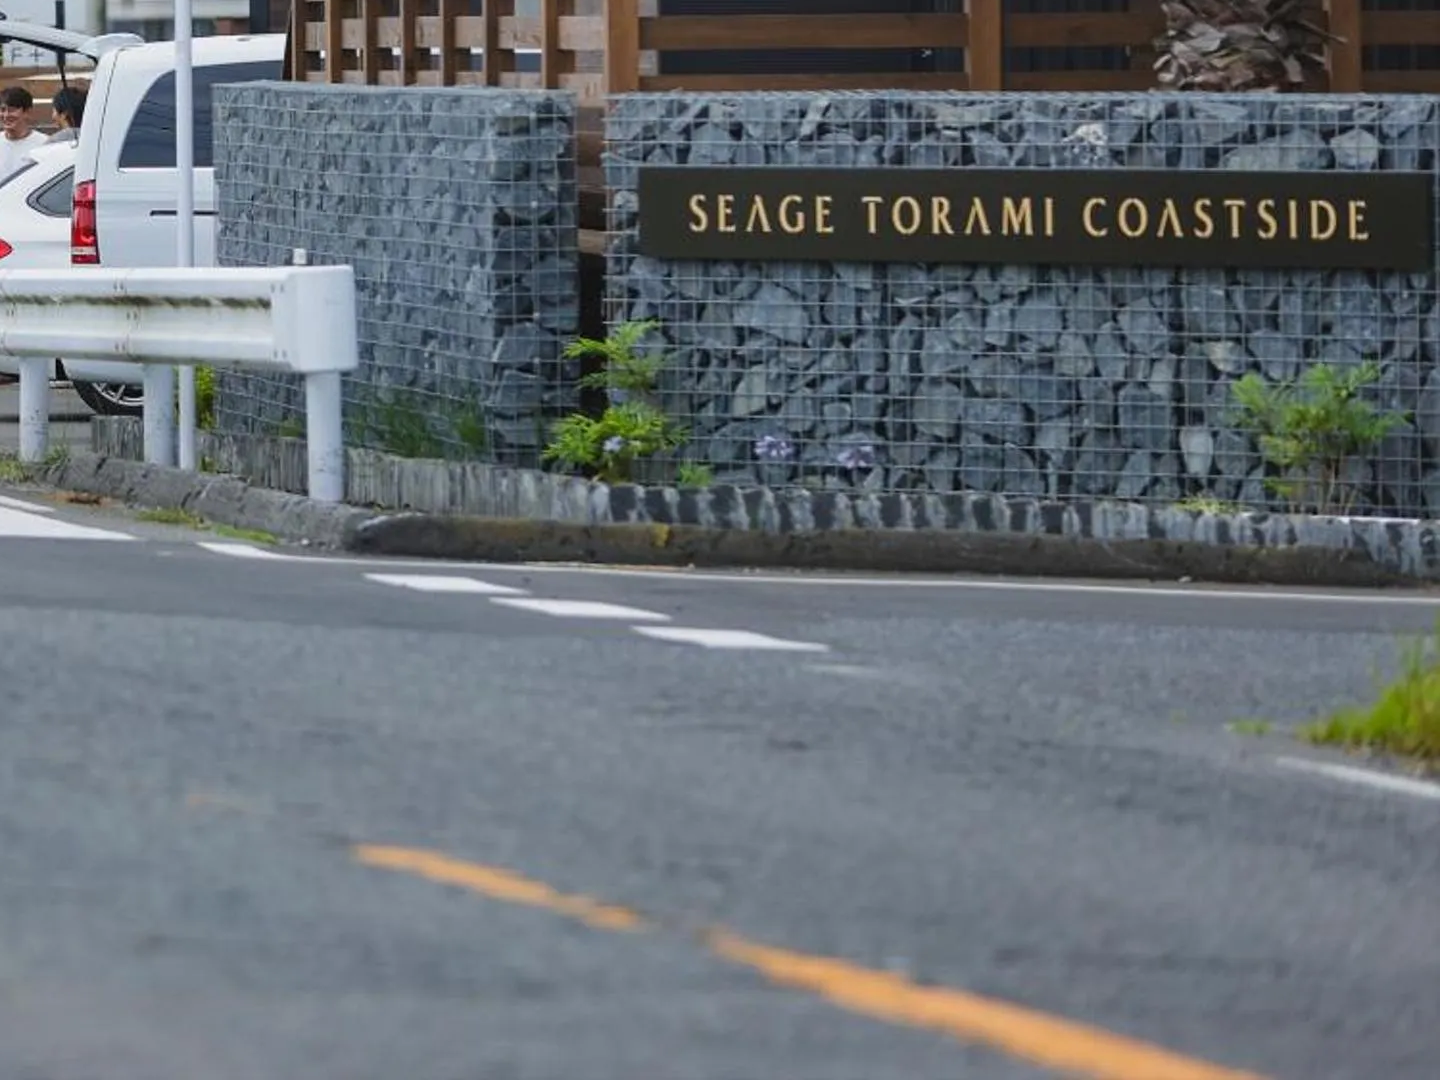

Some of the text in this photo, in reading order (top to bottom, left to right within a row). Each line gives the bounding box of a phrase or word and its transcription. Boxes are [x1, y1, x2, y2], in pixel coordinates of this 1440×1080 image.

[688, 193, 1370, 241] SEAGE TORAMI COASTSIDE
